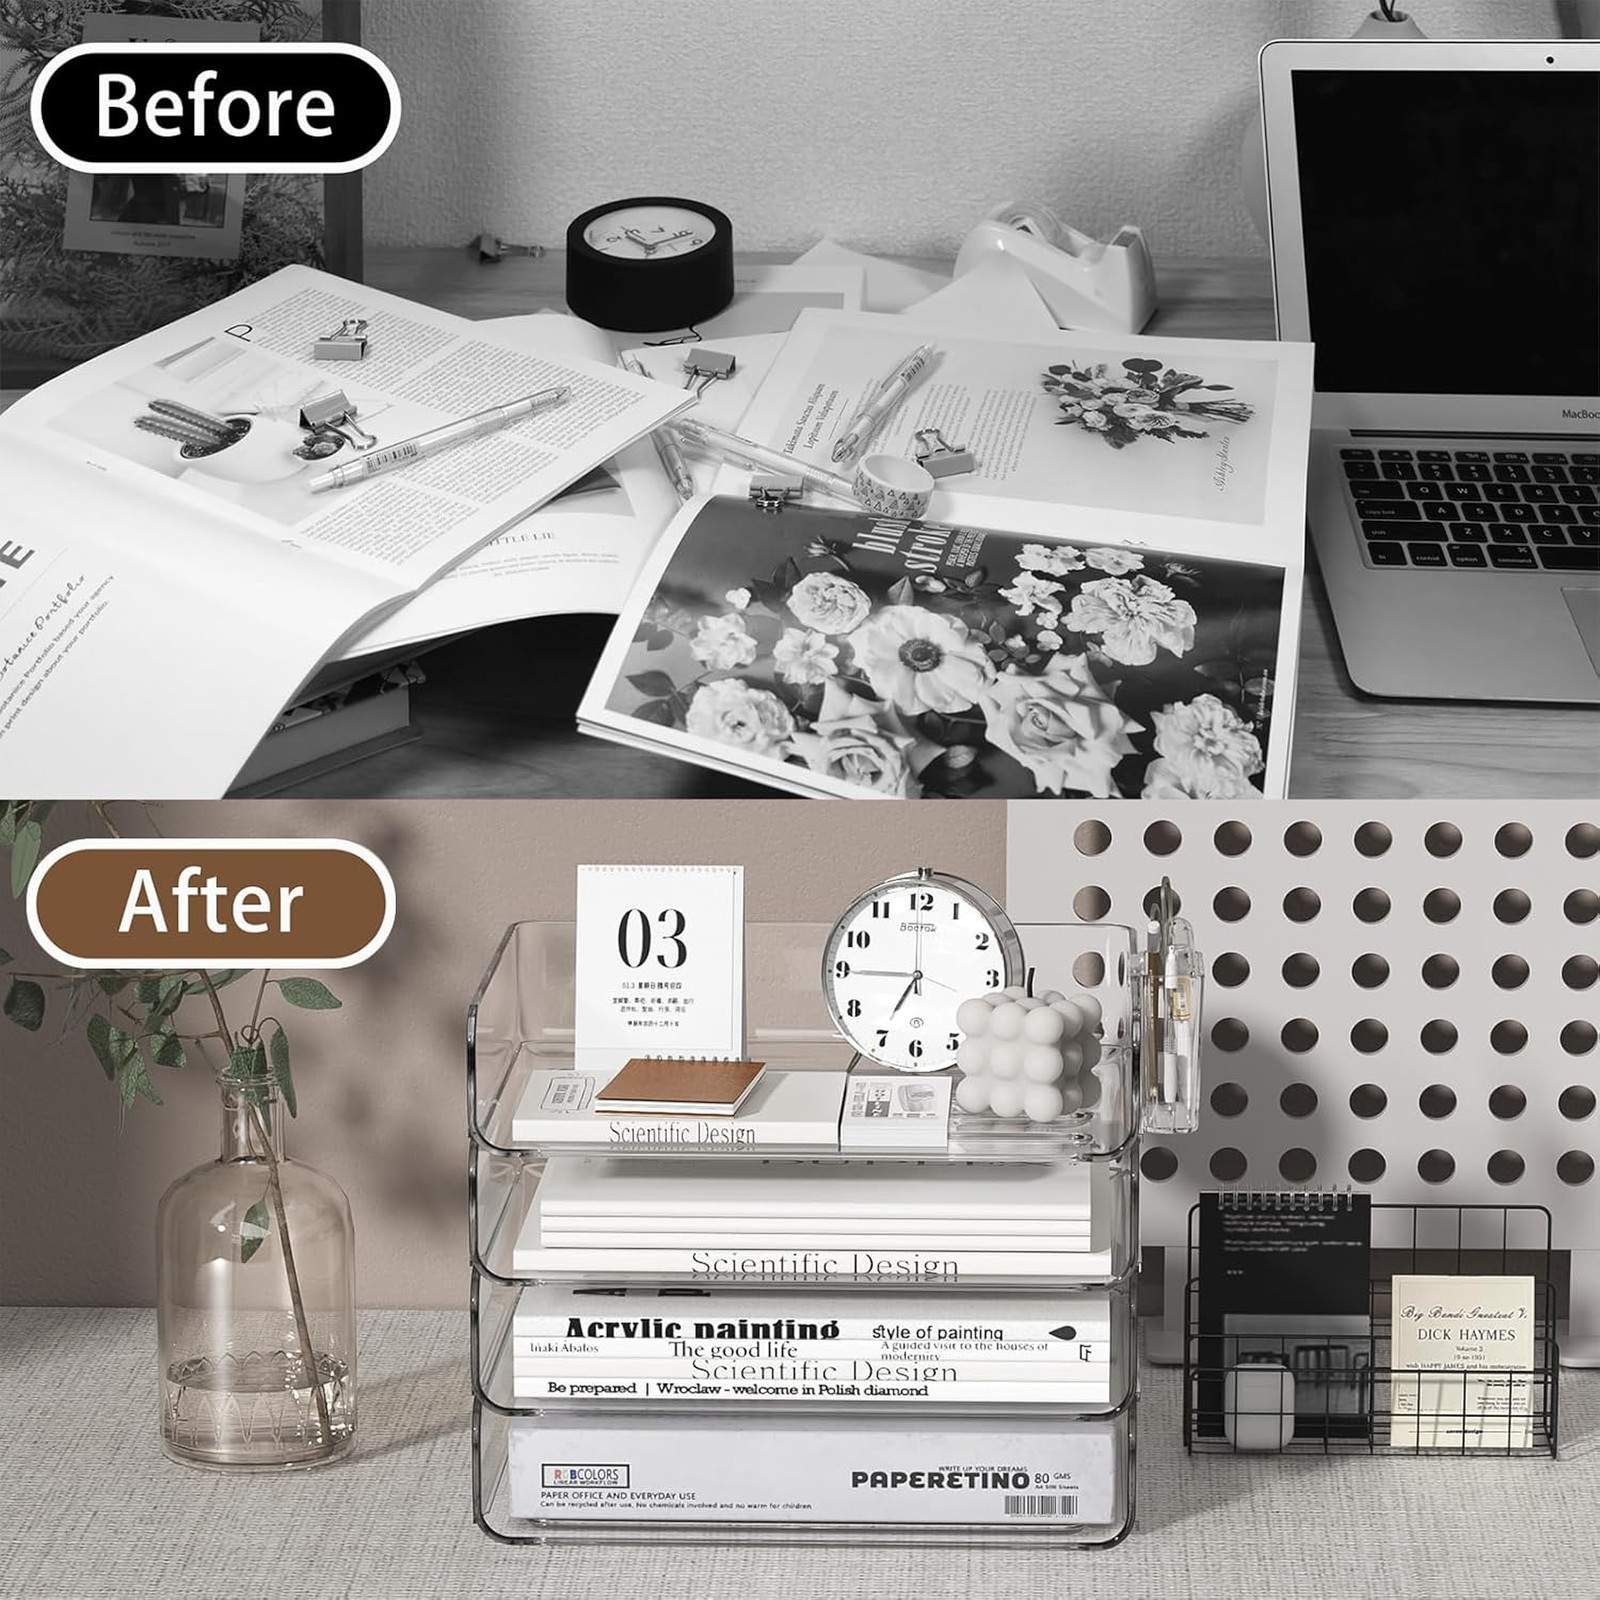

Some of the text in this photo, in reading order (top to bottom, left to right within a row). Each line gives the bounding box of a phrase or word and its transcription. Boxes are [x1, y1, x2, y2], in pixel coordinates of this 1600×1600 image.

[872, 901, 890, 918] 11
[909, 893, 934, 911] 12
[953, 902, 960, 920] 1
[618, 908, 687, 968] 03
[847, 931, 871, 949] 10
[975, 932, 989, 950] 2
[836, 961, 850, 979] 9
[986, 969, 1000, 988] 3
[847, 999, 861, 1018] 8
[876, 1029, 889, 1047] 7
[946, 1033, 960, 1051] 5
[909, 1040, 923, 1058] 6
[609, 1121, 756, 1144] Scientific Design
[692, 1252, 959, 1275] Scientific Design
[1400, 1305, 1424, 1322] Big
[566, 1318, 682, 1339] Acrylic
[872, 1325, 1004, 1341] style of painting
[1418, 1328, 1516, 1340] DICK HAYMES
[668, 1340, 798, 1359] The good life
[893, 1341, 931, 1351] guided
[933, 1341, 956, 1350] visit
[960, 1342, 972, 1350] to
[975, 1341, 993, 1350] the
[996, 1342, 1034, 1351] houses
[881, 1352, 941, 1361] modernity
[692, 1359, 958, 1382] Scientific Design
[548, 1382, 566, 1393] Be
[570, 1382, 637, 1396] prepared
[656, 1383, 722, 1395] Wroclaw
[732, 1384, 799, 1396] welcome
[802, 1384, 815, 1396] in
[819, 1384, 860, 1396] Polish
[864, 1385, 929, 1397] diamond
[852, 1471, 1071, 1489] PAPERETINO 80 GMS
[541, 1491, 696, 1500] PAPER OFFICE AND EVERYDAY USE
[568, 1501, 598, 1509] recycled
